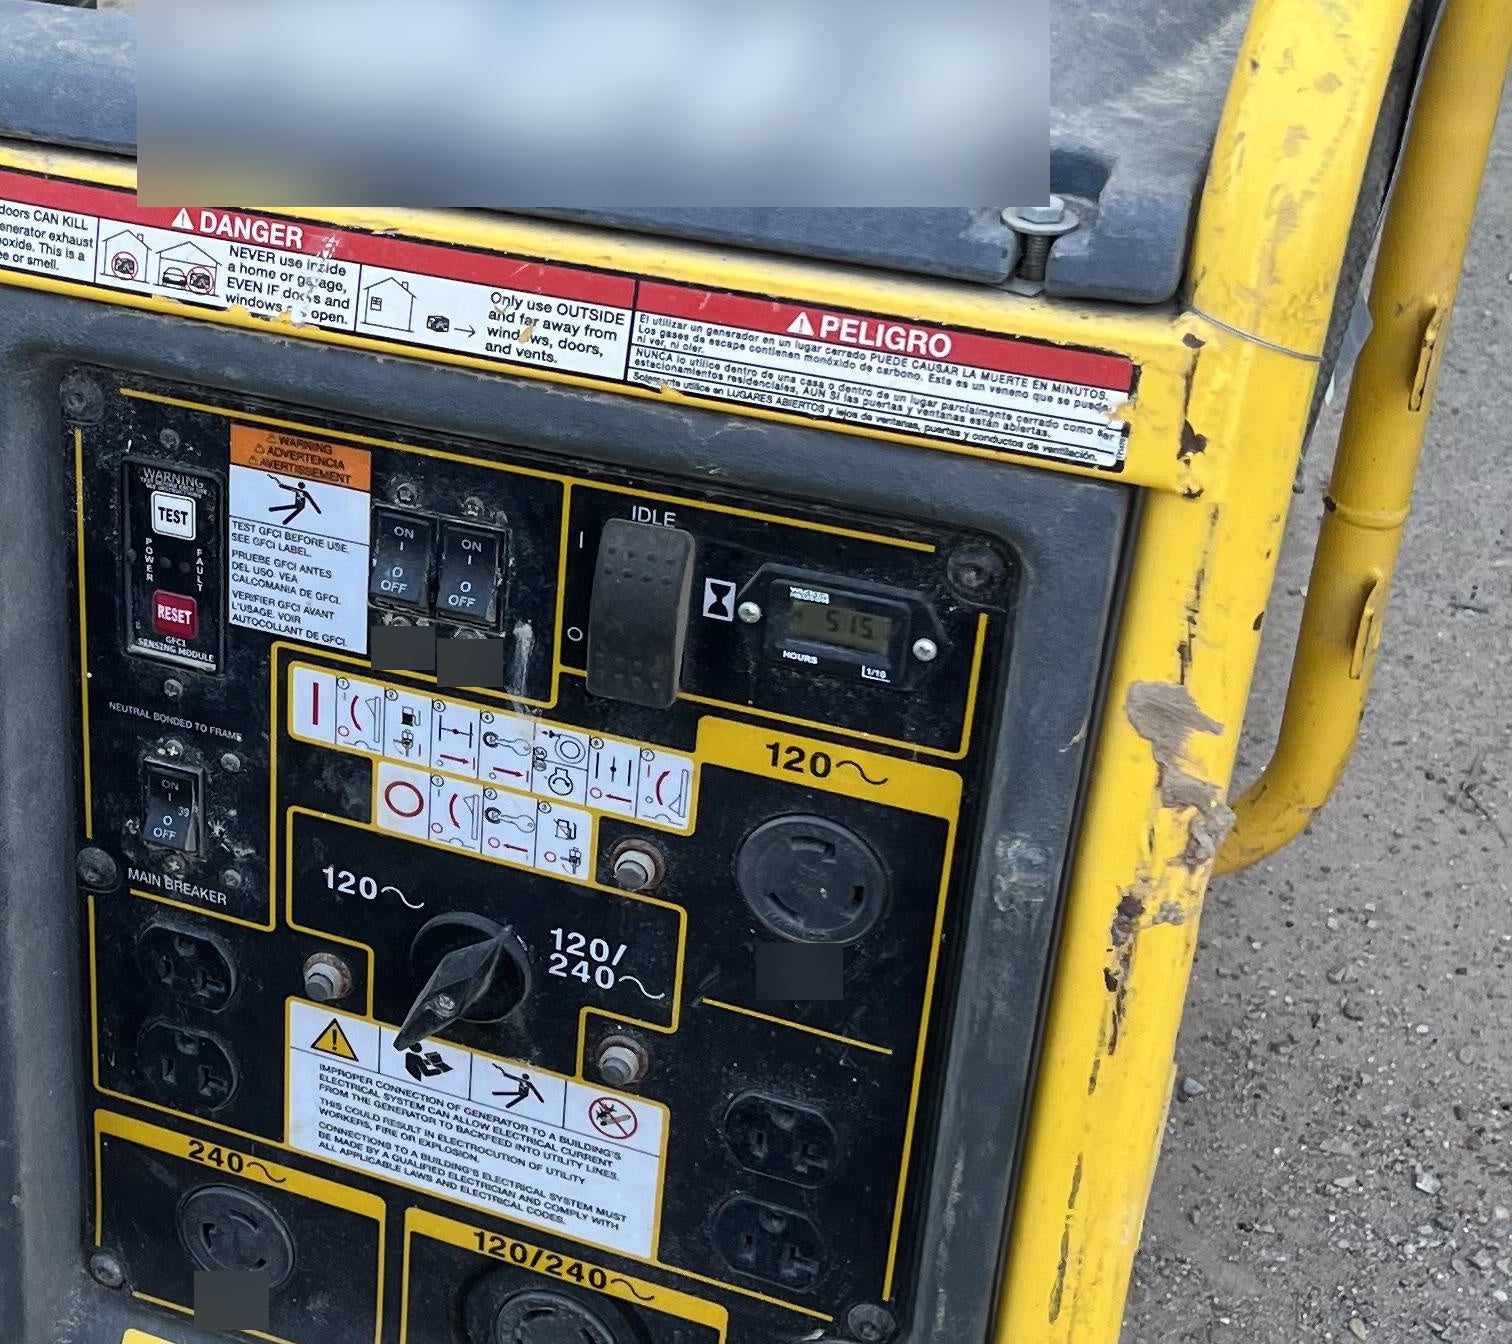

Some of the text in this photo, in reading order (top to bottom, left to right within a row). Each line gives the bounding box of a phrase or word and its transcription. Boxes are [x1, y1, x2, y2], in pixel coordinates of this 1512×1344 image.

[33, 209, 58, 225] CAN
[62, 214, 88, 230] KILL
[199, 210, 303, 250] DANGER
[48, 228, 93, 248] exhaust
[12, 253, 23, 263] or
[27, 254, 59, 270] smell.
[40, 243, 62, 257] This
[65, 247, 74, 259] is
[77, 252, 85, 261] a
[229, 244, 275, 264] NEVER
[279, 256, 303, 269] use
[227, 262, 235, 272] a
[239, 261, 276, 280] home
[279, 271, 293, 283] or
[226, 275, 262, 293] EVEN
[266, 283, 279, 297] IF
[324, 293, 349, 309] and
[225, 290, 348, 327] windows open.
[490, 290, 625, 326] Only use OUTSIDE
[488, 307, 618, 342] and far away from
[486, 324, 604, 357] windws, doors,
[819, 315, 952, 358] PELIGRO
[485, 339, 558, 364] and vents.
[639, 313, 1109, 401] El utilizar un generador en un lugar cerrado PUEDE CAUSAR LA MUERTE EN MINUTOS.
[278, 436, 333, 455] WARNING
[266, 446, 345, 470] ADVERTENCIA
[144, 467, 204, 489] WARNING
[259, 458, 352, 484] AVERTISSEMENT
[158, 506, 188, 525] TEST
[631, 505, 676, 528] IDLE
[231, 519, 255, 533] TEST
[258, 525, 281, 539] GFCI
[284, 530, 324, 548] BEFORE
[231, 531, 250, 544] SEE
[252, 536, 275, 549] GFCI
[393, 526, 414, 539] ON
[461, 539, 482, 552] ON
[196, 549, 204, 592] FAULT
[231, 548, 331, 579] PRUEBE GFCI ANTES
[231, 561, 249, 573] DEL
[278, 571, 298, 583] VEA
[299, 587, 312, 598] DE
[380, 579, 407, 594] OFF
[277, 599, 300, 613] GFCI
[303, 605, 334, 620] AVANT
[448, 595, 476, 608] OFF
[157, 604, 192, 625] RESET
[231, 612, 303, 637] AUTOCOLLANT
[305, 629, 319, 640] DE
[783, 650, 818, 665] HOURS
[109, 701, 243, 742] NEUTRAL BONDED TO FRAME
[161, 779, 179, 791] ON
[153, 828, 176, 841] OFF
[128, 868, 227, 906] MAIN BREAKER
[319, 1063, 372, 1086] IMPROPER
[375, 1079, 444, 1107] CONNECTION
[446, 1101, 460, 1112] OF
[463, 1106, 528, 1133] GENERATOR
[531, 1126, 545, 1138] TO
[548, 1131, 556, 1141] A
